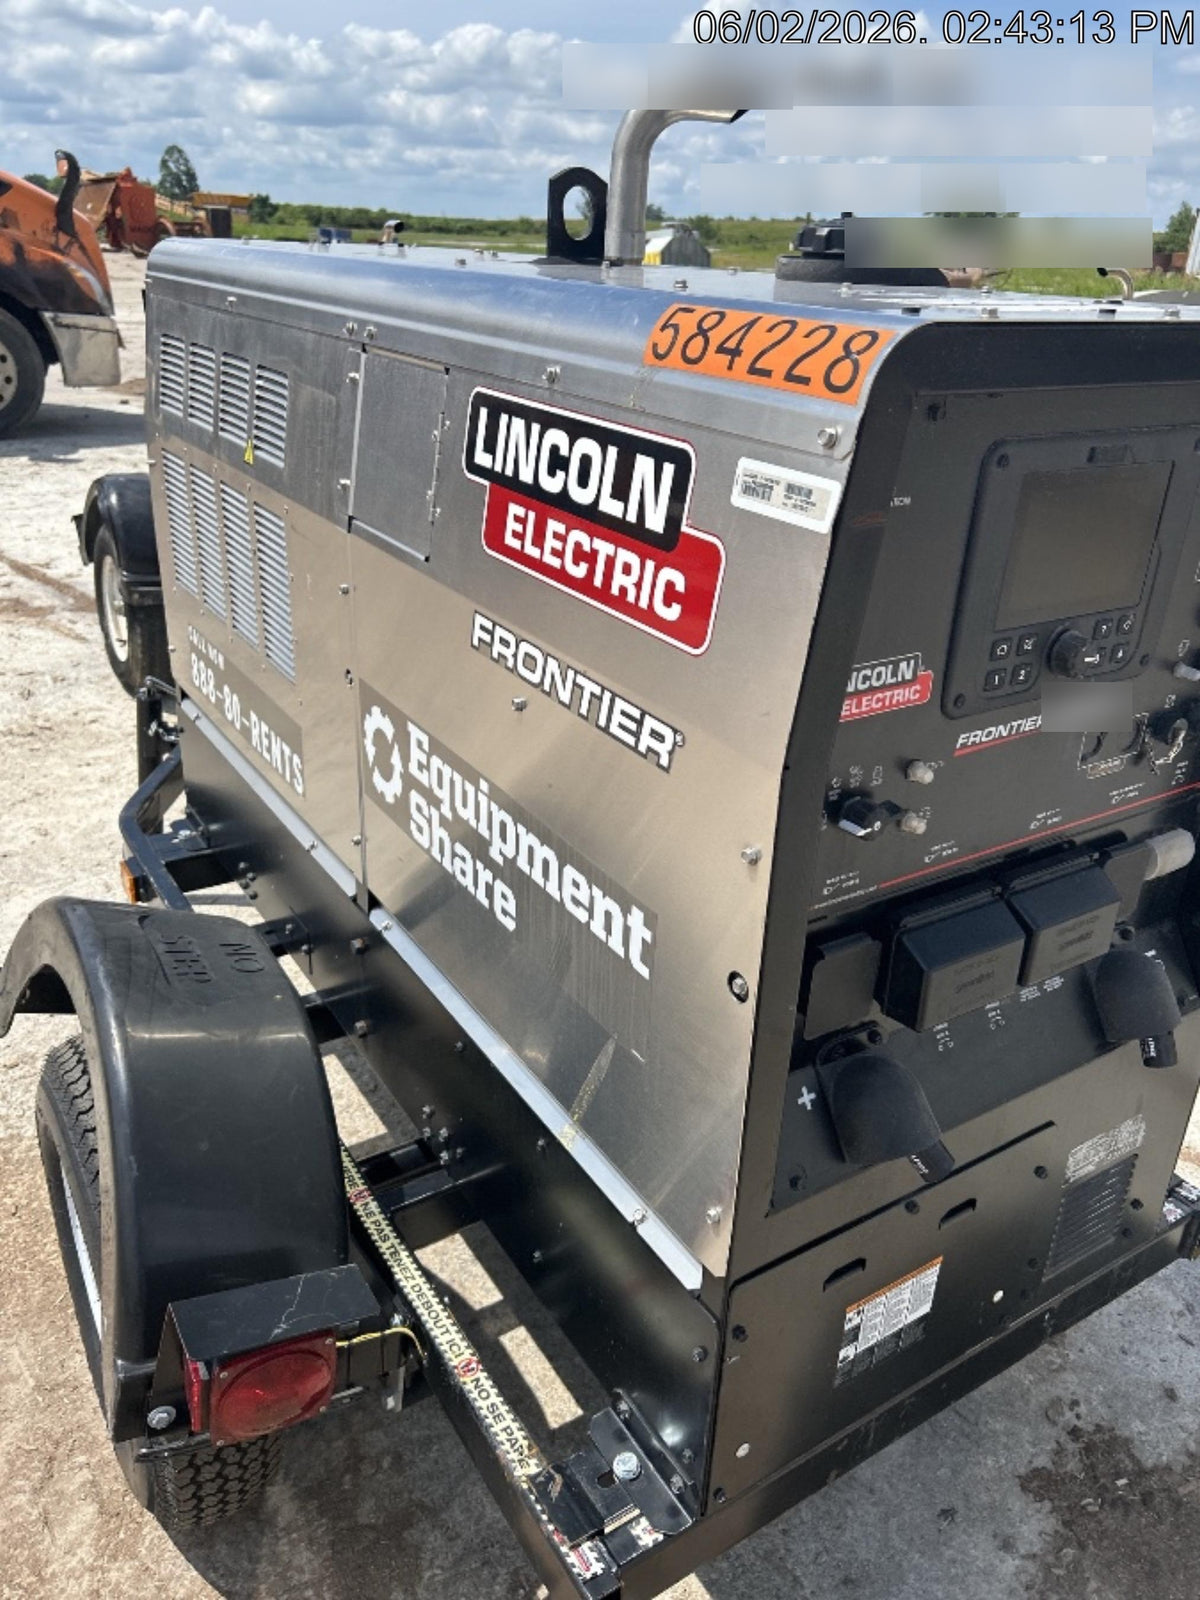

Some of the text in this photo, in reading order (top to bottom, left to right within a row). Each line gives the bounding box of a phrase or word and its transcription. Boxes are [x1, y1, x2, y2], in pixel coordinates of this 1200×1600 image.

[652, 307, 879, 394] 584228
[473, 406, 676, 535] LINCOLN
[503, 501, 686, 622] ELECTRIC
[191, 651, 304, 795] 888-80-RENTS
[840, 684, 922, 715] ELECTRIC
[406, 719, 653, 980] Equipment
[409, 789, 517, 932] Share
[161, 935, 212, 984] STEP
[219, 943, 265, 974] NO
[360, 1201, 465, 1359] NE PAS TENEZ DEBOUT ICI
[470, 1376, 491, 1401] NO
[486, 1402, 506, 1424] SE
